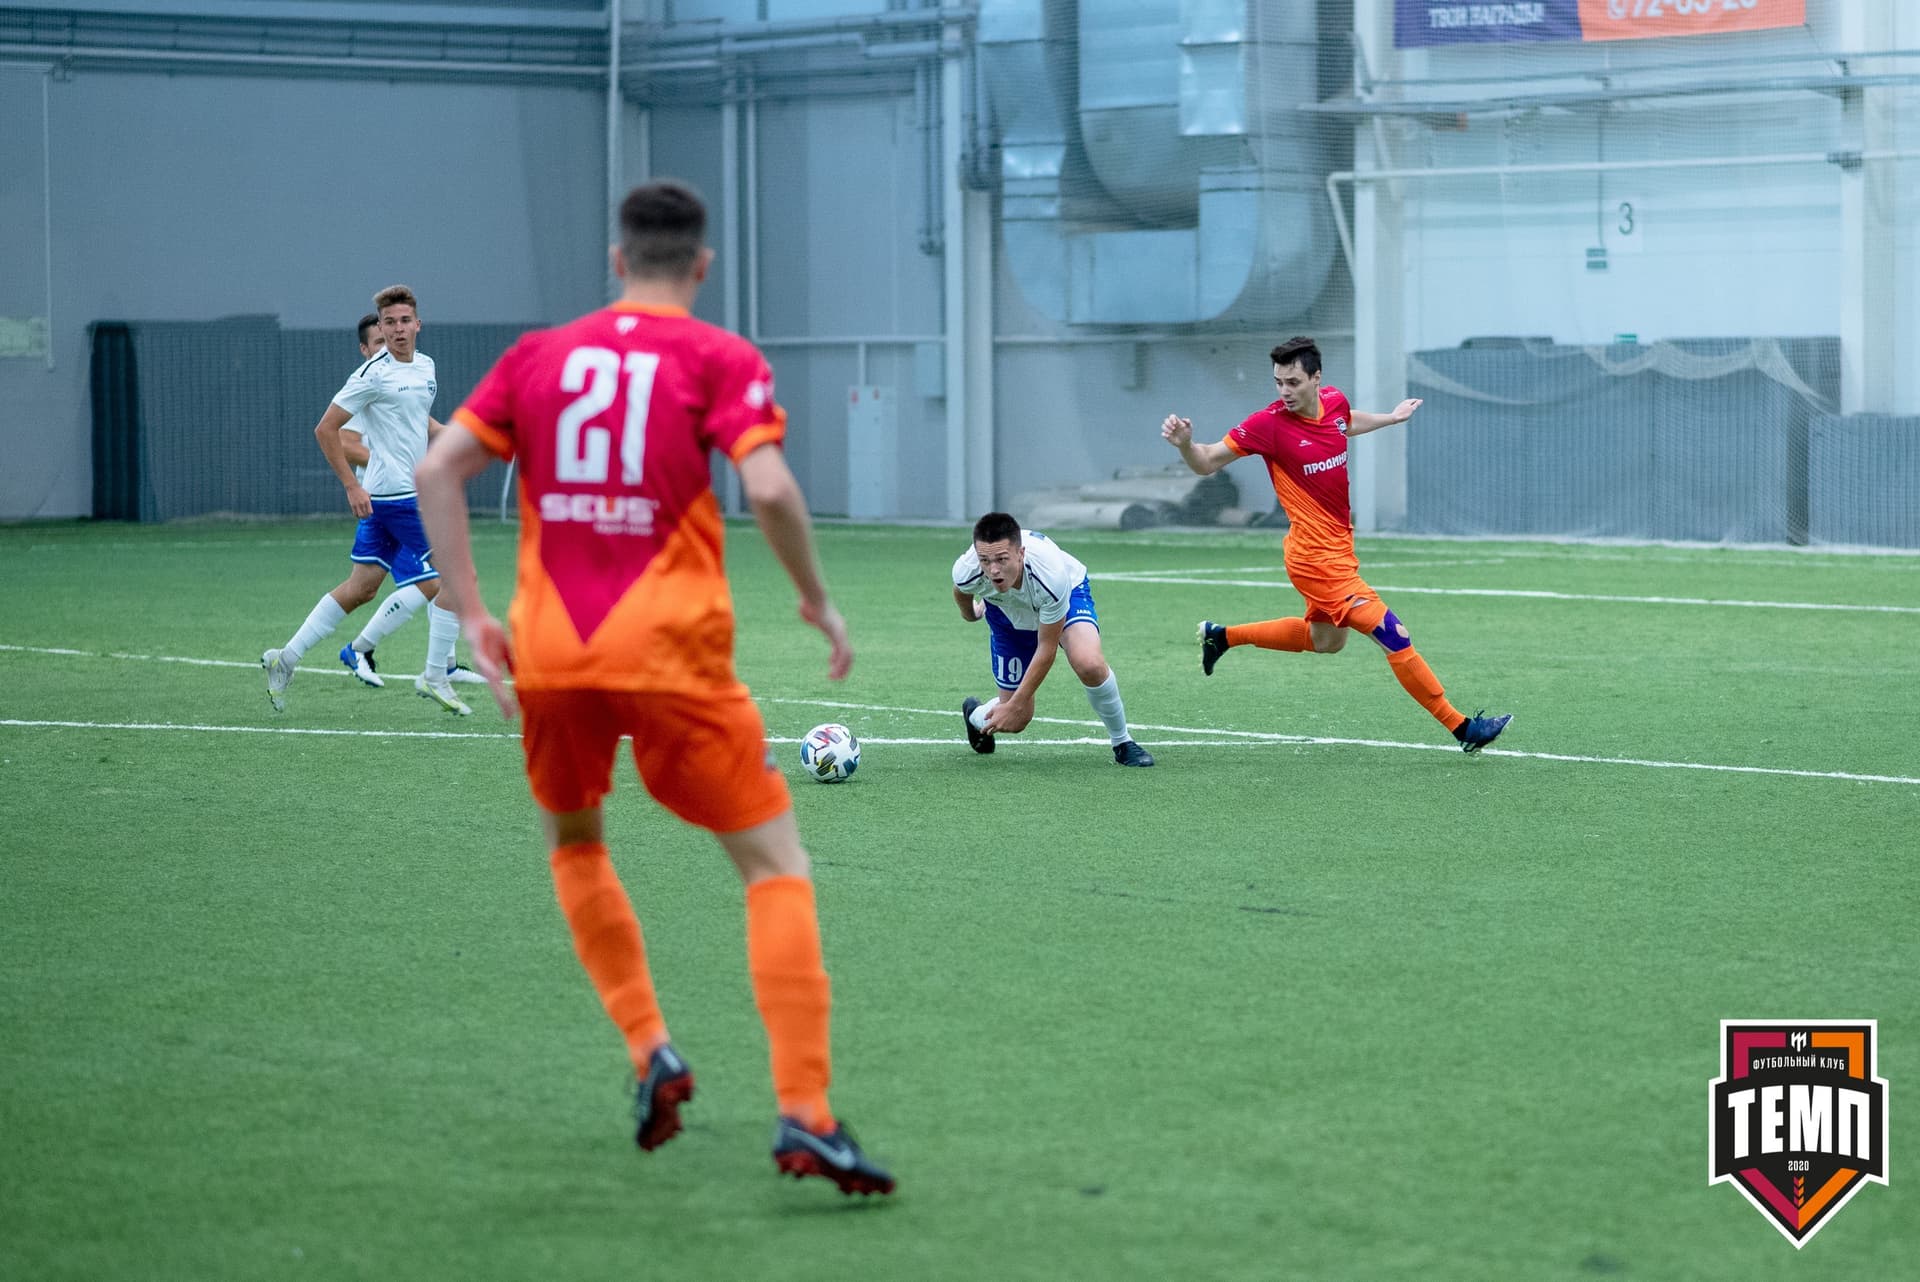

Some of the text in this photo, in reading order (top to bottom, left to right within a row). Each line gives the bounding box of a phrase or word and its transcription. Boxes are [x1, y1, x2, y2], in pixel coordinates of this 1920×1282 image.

[1619, 202, 1633, 235] 3
[555, 346, 660, 485] 21
[997, 655, 1023, 682] 19
